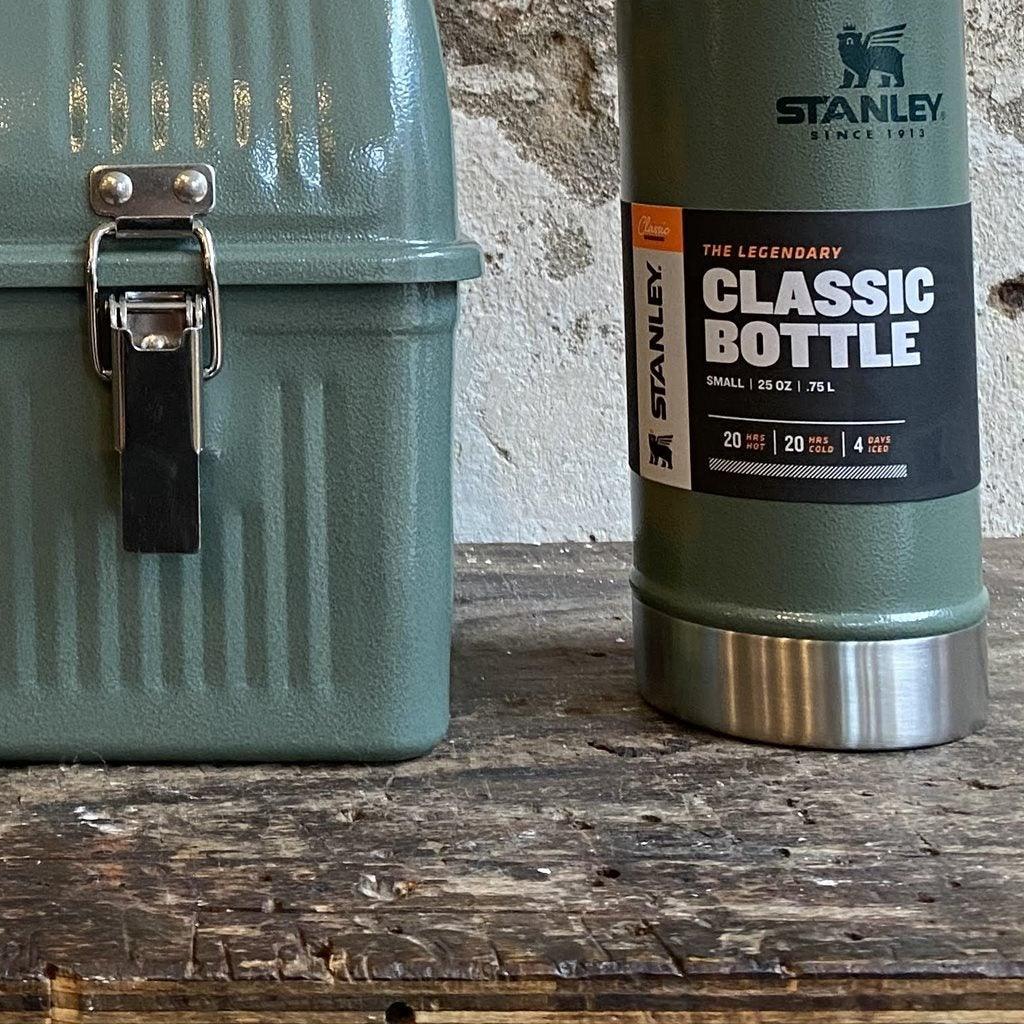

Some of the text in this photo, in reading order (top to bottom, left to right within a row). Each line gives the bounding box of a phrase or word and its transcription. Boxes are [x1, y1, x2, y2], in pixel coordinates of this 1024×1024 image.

[776, 93, 943, 124] STANLEY
[811, 129, 925, 140] SINCE 1913
[638, 215, 671, 237] Classic
[703, 244, 841, 259] THE LEGENDARY
[702, 267, 935, 317] CLASSIC
[647, 261, 667, 421] STANLEY
[704, 320, 921, 369] BOTTLE
[706, 375, 744, 389] SMALL
[758, 379, 774, 390] 25
[776, 380, 792, 392] OZ
[724, 431, 741, 448] 20
[746, 433, 765, 442] HRS
[784, 436, 804, 453] 20
[808, 436, 829, 444] HRS
[853, 437, 863, 453] 4
[867, 436, 891, 444] DAYS
[746, 442, 765, 451] HOT
[808, 445, 834, 453] COLD
[867, 444, 889, 453] ICED
